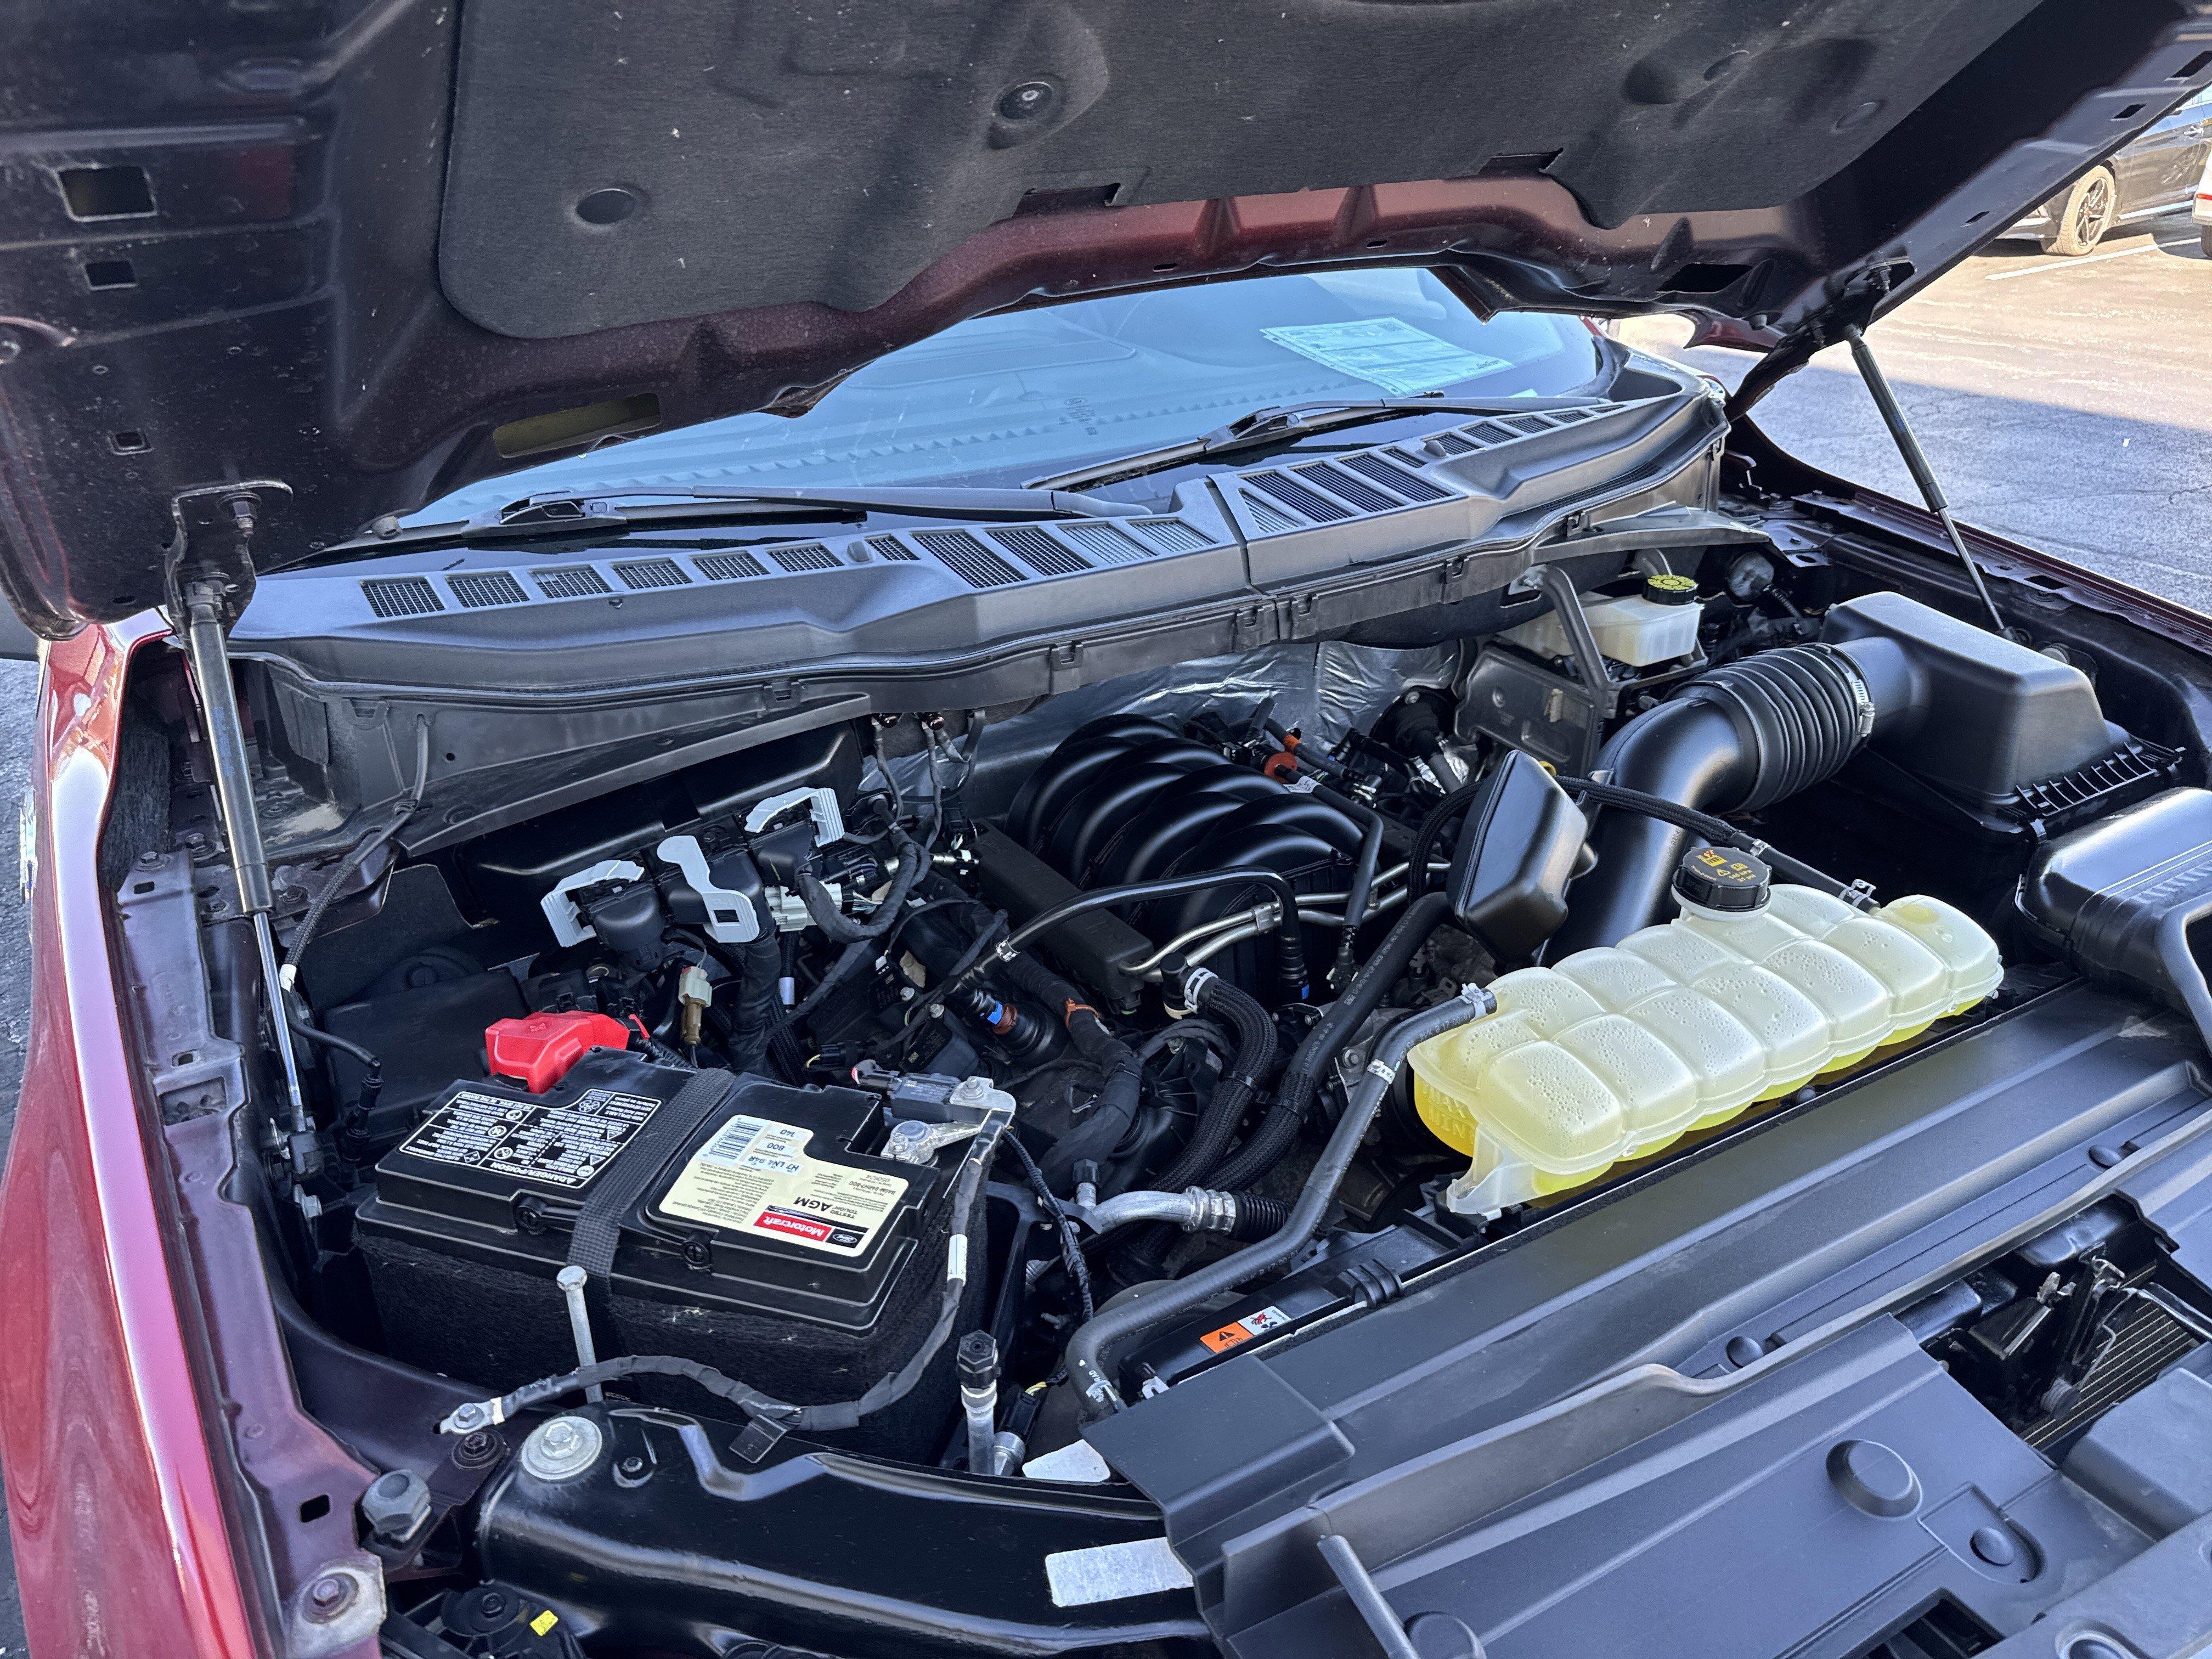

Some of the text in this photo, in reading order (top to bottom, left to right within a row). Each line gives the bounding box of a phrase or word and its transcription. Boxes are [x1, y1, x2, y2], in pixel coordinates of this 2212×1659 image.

[1429, 1108, 1465, 1138] MIN
[767, 1143, 786, 1151] 800
[490, 1161, 568, 1183] DANGER/POISON
[793, 1197, 833, 1211] AGM
[830, 1210, 855, 1219] TESTED
[763, 1216, 825, 1237] Motorcraft
